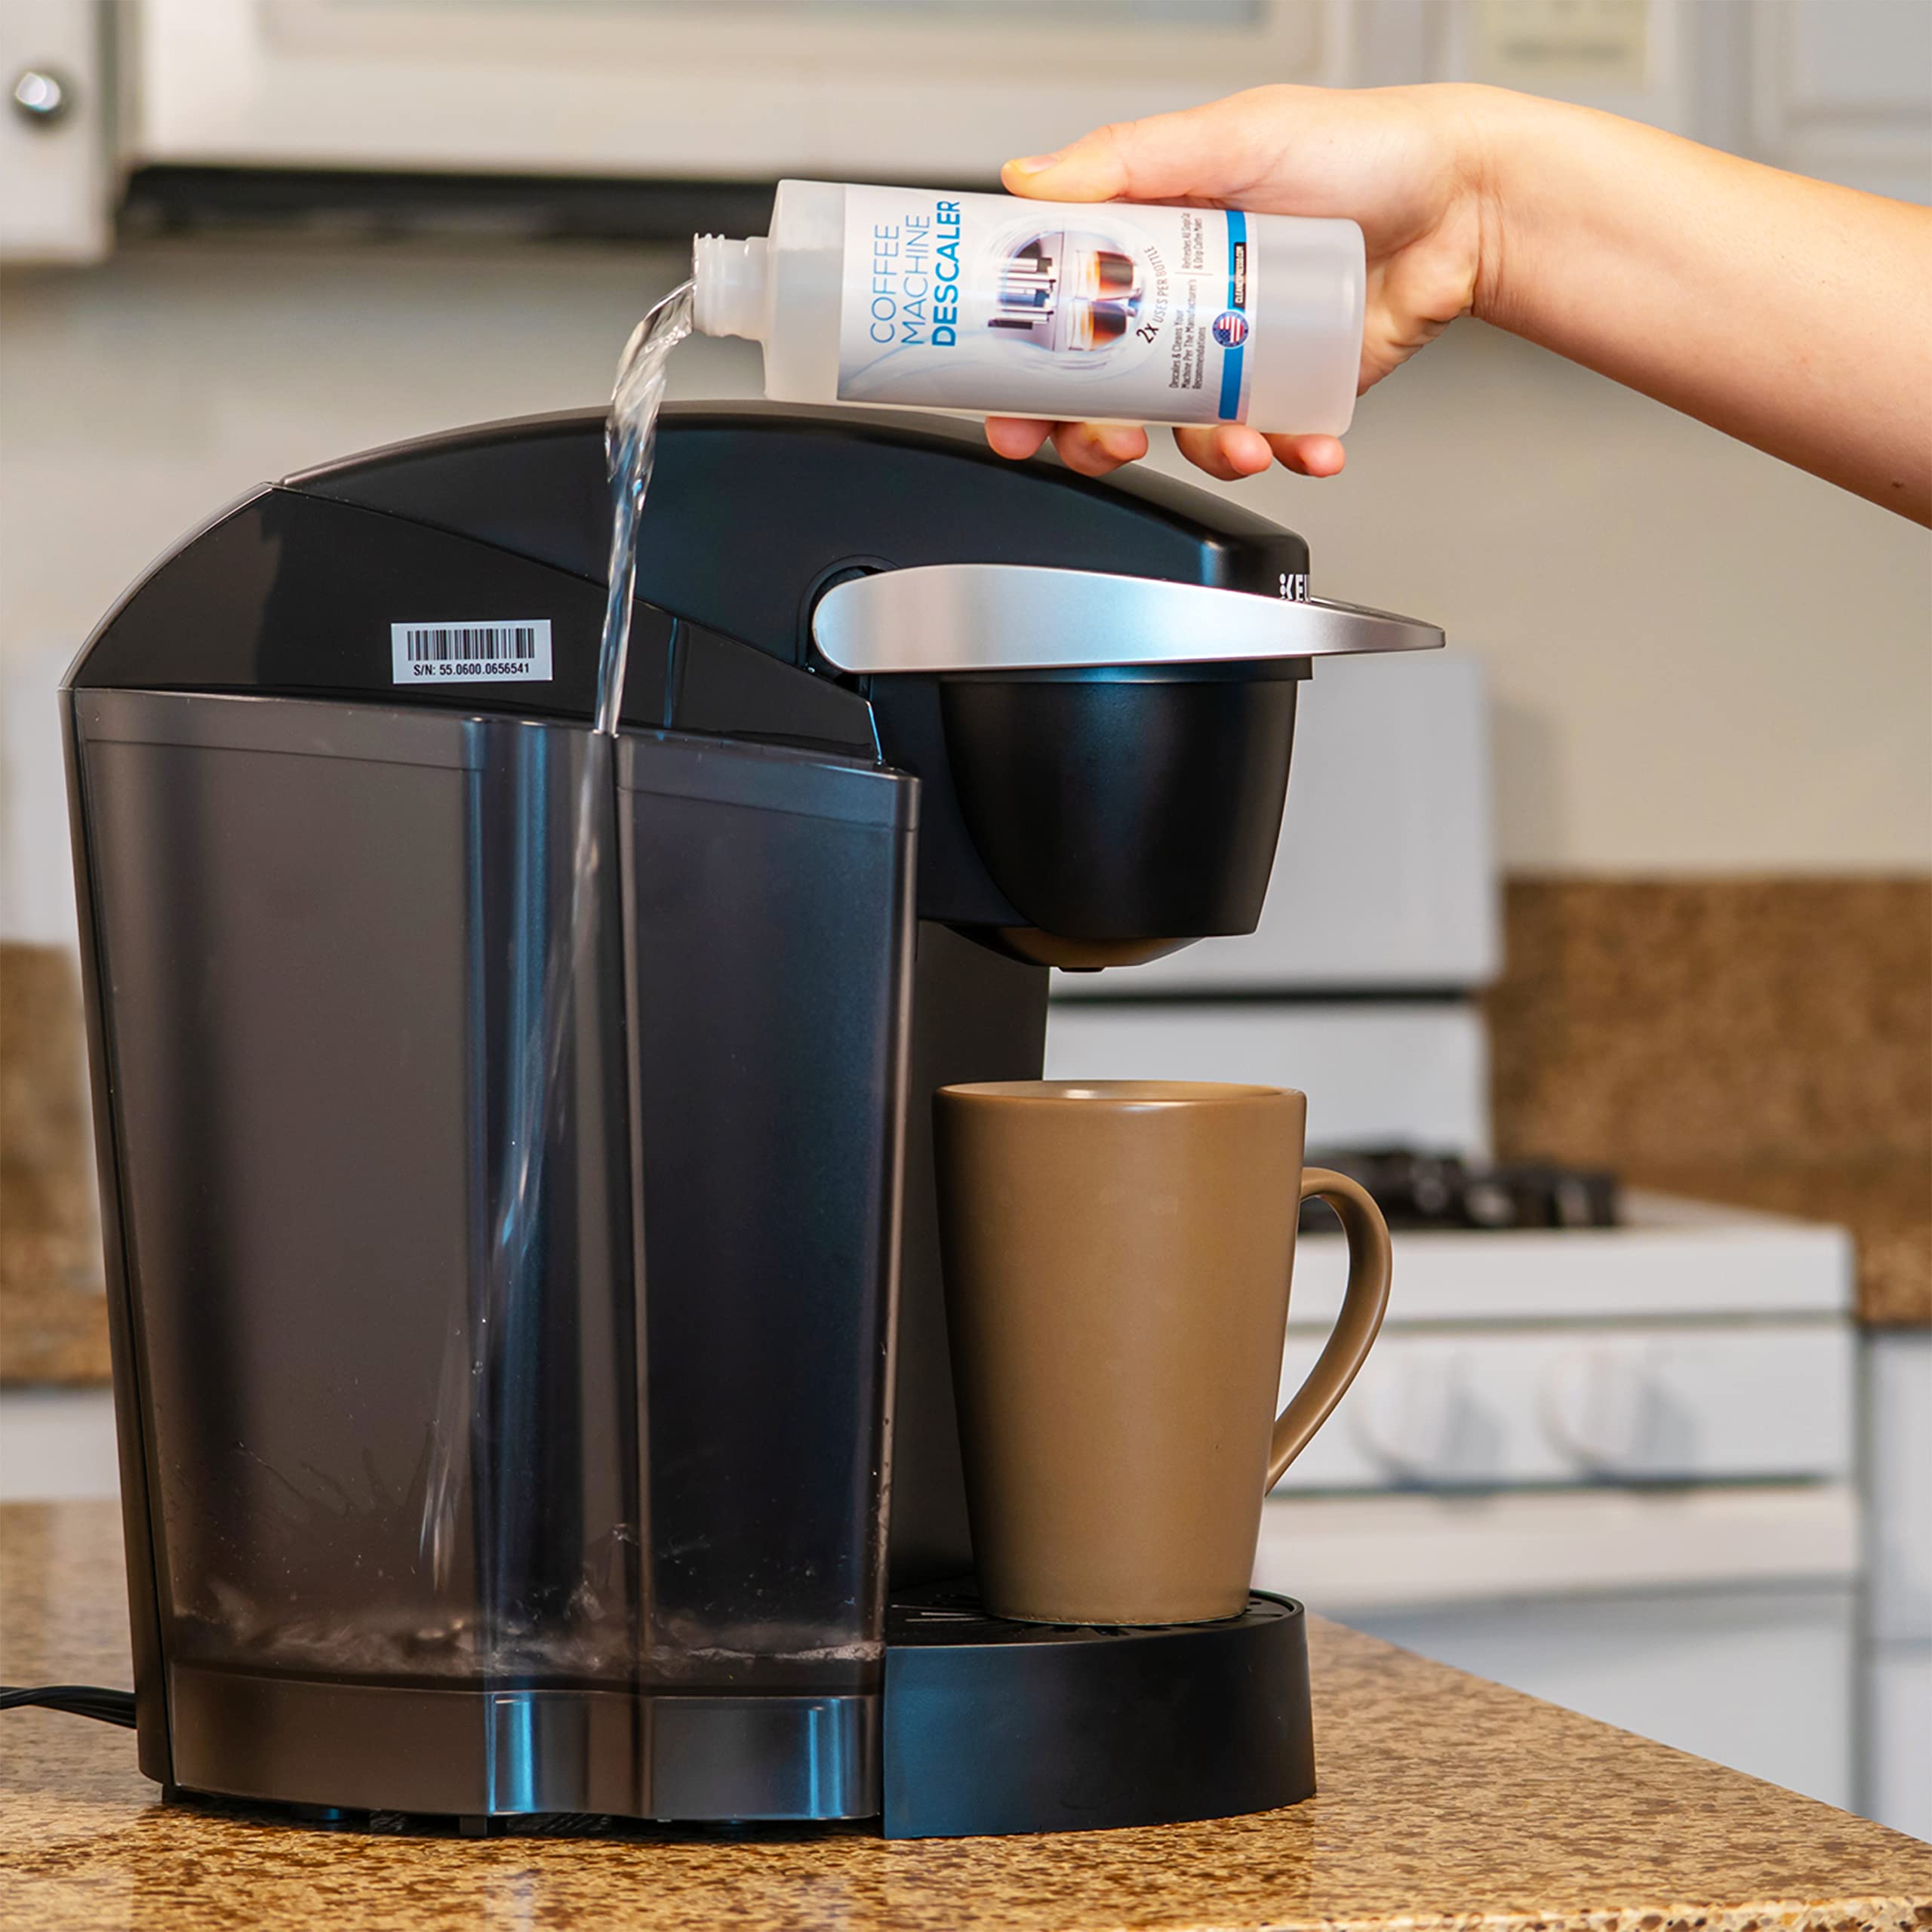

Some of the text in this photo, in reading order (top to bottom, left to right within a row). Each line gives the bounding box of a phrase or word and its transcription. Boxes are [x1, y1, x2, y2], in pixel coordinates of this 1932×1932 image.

[1182, 240, 1192, 269] Refreshes
[1193, 232, 1203, 249] Coffee
[1143, 245, 1167, 277] BOTTLE
[1193, 251, 1204, 263] Drip
[870, 225, 900, 343] COFFEE
[900, 215, 930, 344] MACHINE
[931, 201, 960, 346] DESCALER
[1157, 278, 1169, 297] PER
[1152, 298, 1168, 324] USES
[1174, 309, 1183, 326] Your
[1172, 328, 1183, 352] Cleans
[1181, 278, 1196, 389] Machine Per The Manufacturer's
[1192, 326, 1206, 389] Recommendations
[1169, 360, 1180, 388] Descales
[414, 663, 530, 676] S/N: 55.0600.0656541
